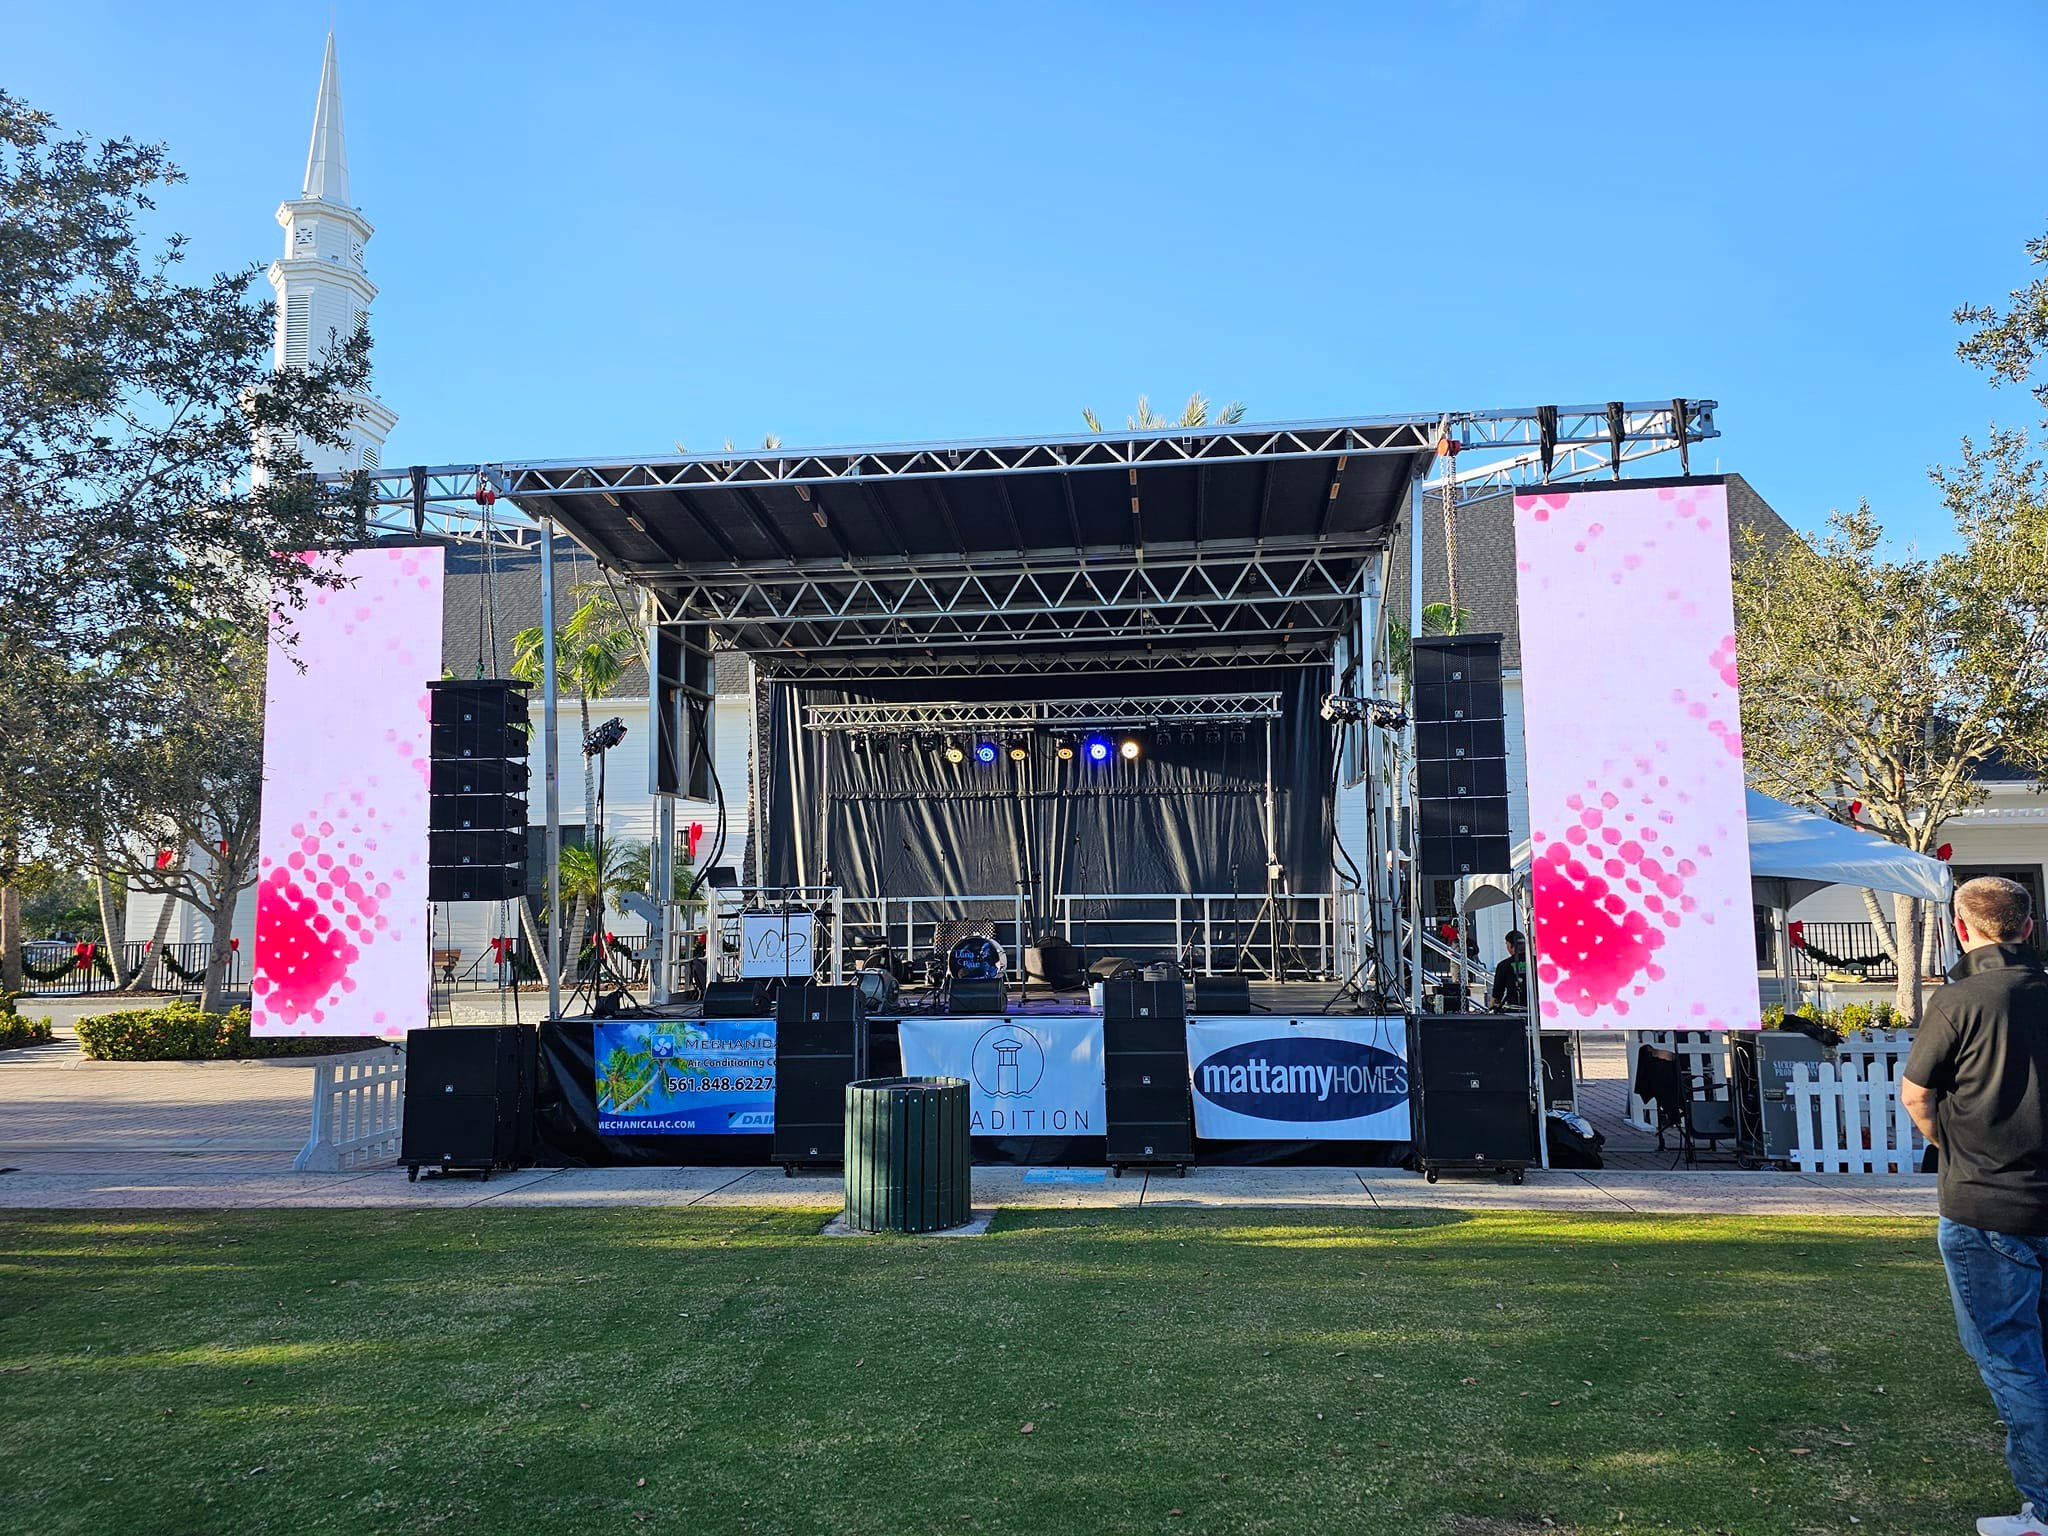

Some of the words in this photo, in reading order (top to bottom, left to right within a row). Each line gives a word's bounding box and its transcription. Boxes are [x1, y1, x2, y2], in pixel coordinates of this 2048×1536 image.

[687, 1059, 700, 1067] Air
[703, 1058, 764, 1068] Conditioning
[669, 1077, 773, 1091] 561.848.6227
[598, 1120, 696, 1129] MECHANICALAC.COM
[969, 1110, 1089, 1130] ADITION
